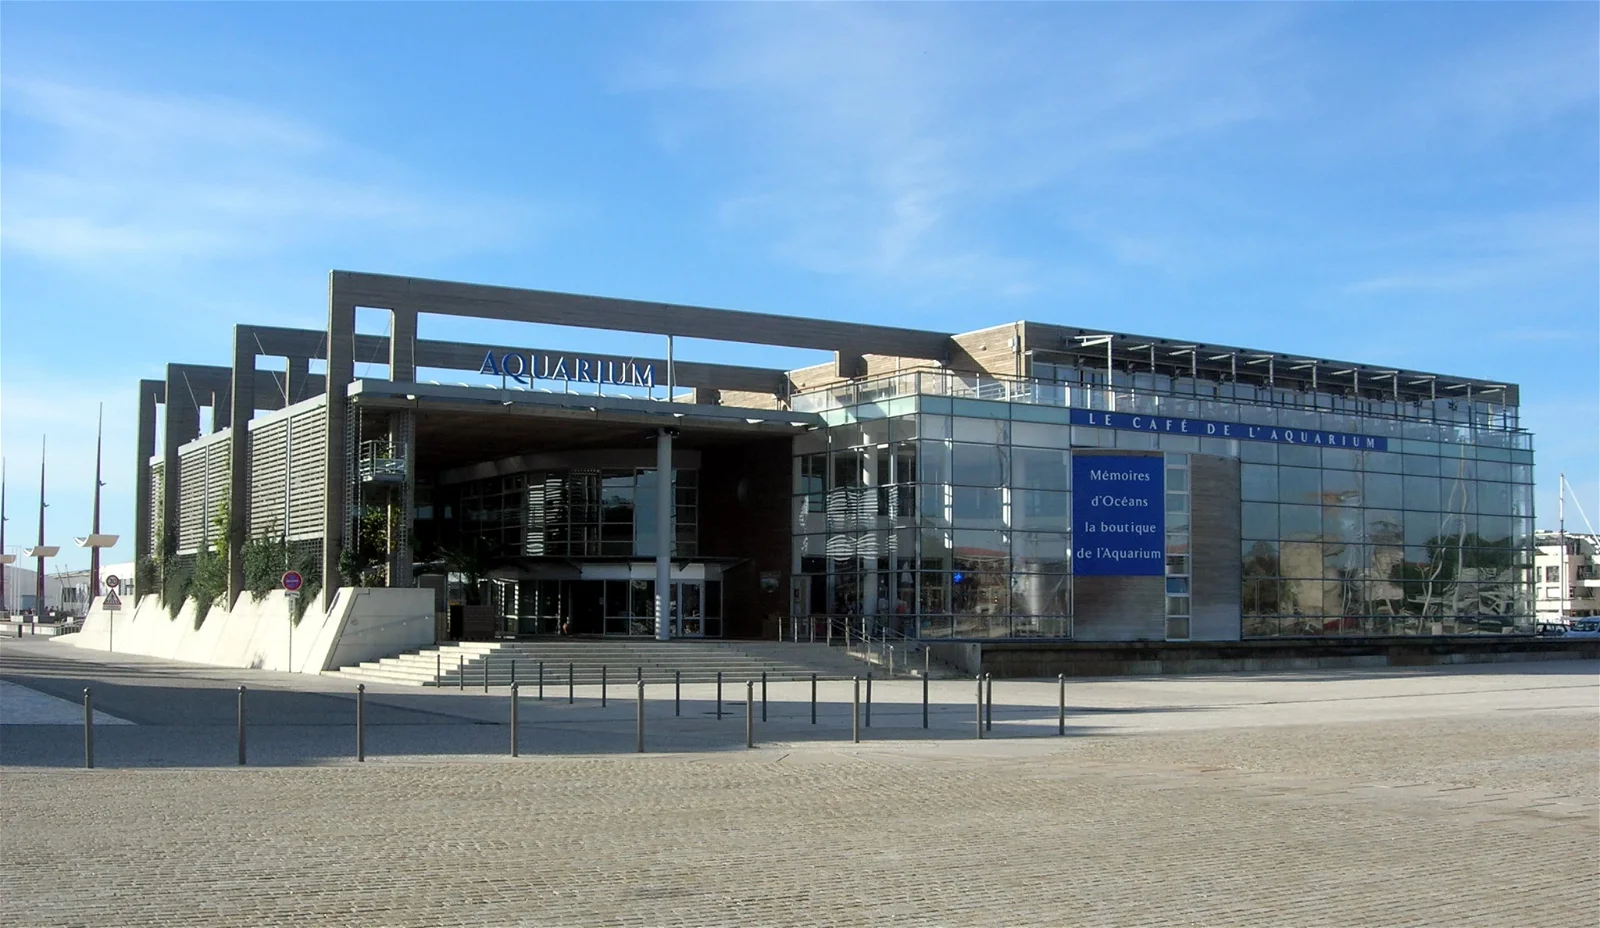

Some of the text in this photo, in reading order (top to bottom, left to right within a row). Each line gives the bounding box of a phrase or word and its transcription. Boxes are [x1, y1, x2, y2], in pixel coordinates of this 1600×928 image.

[479, 350, 655, 388] AQUARIUM
[1089, 412, 1375, 448] LE CAFÉ DE L'AQUARIUM
[1090, 469, 1150, 481] Mémoires
[1091, 495, 1148, 507] d'Océans
[1085, 521, 1156, 535] la boutique
[1076, 547, 1161, 561] de l'Aquarium
